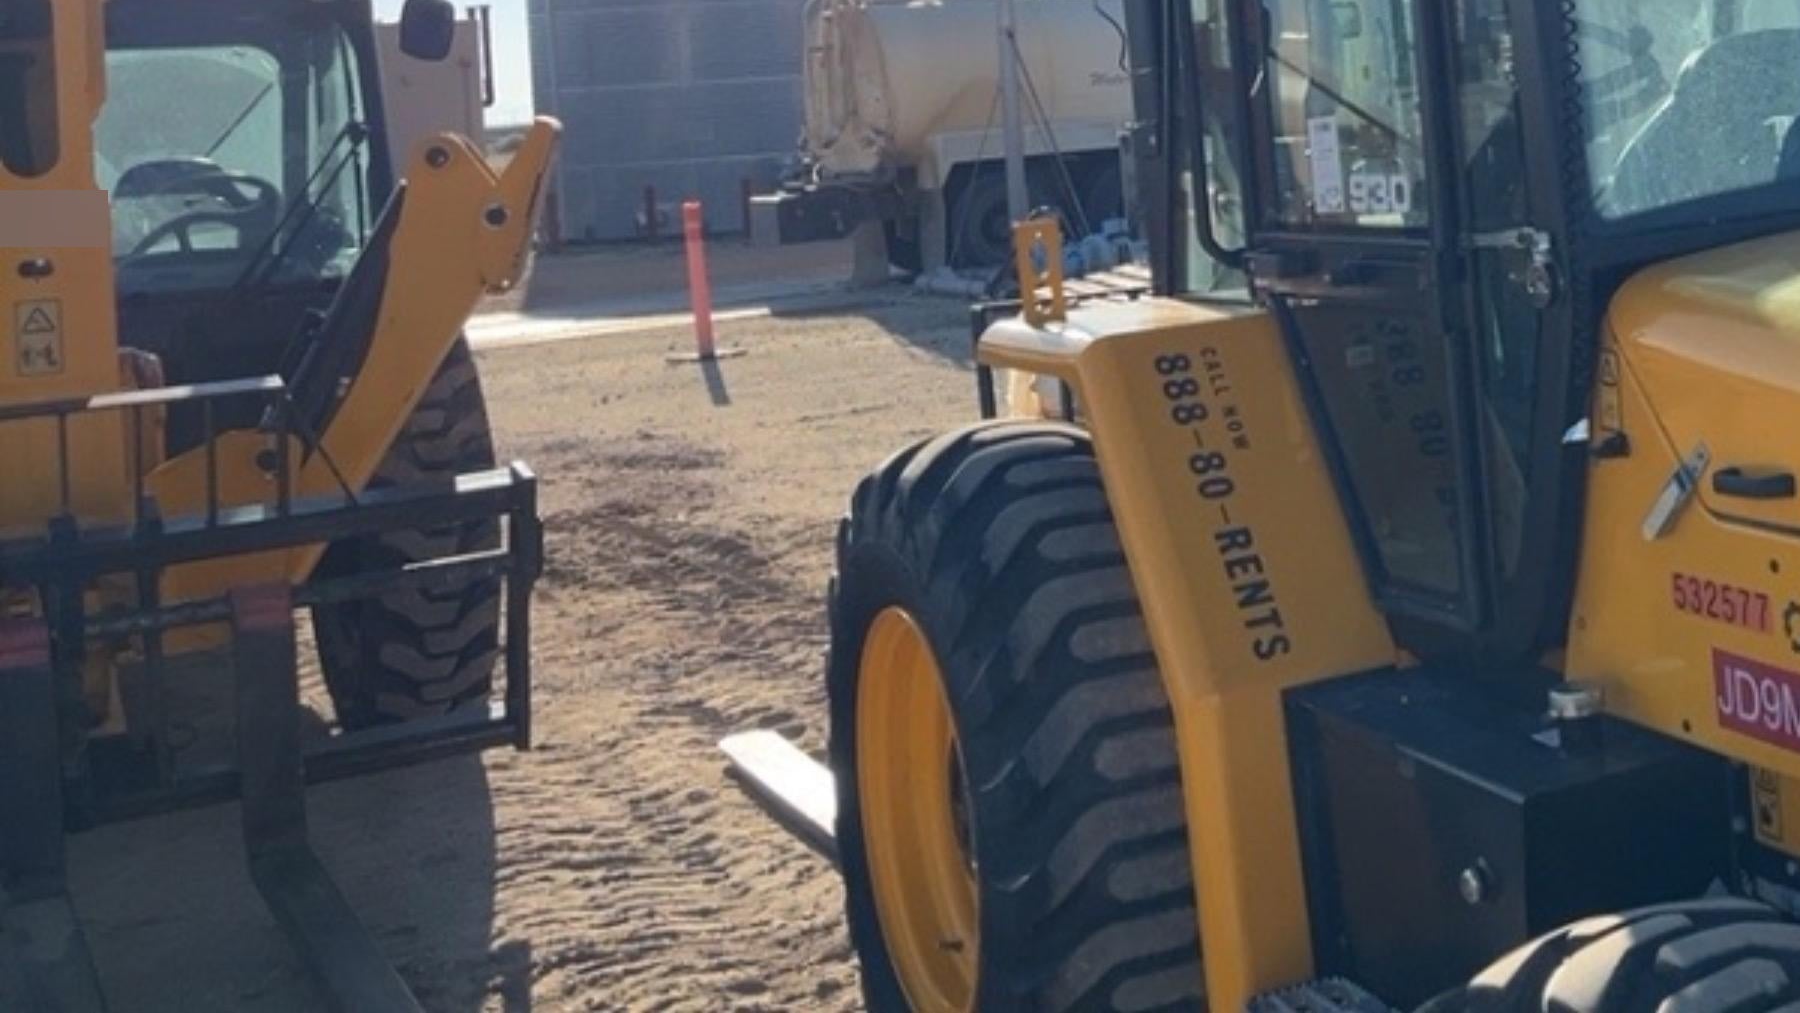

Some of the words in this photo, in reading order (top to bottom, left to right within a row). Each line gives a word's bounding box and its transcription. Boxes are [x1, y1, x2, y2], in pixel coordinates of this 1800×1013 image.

[1200, 346, 1231, 396] CALL
[1222, 405, 1248, 450] NOW
[1155, 353, 1290, 661] 888-80-RENTS
[1672, 572, 1770, 633] 532577
